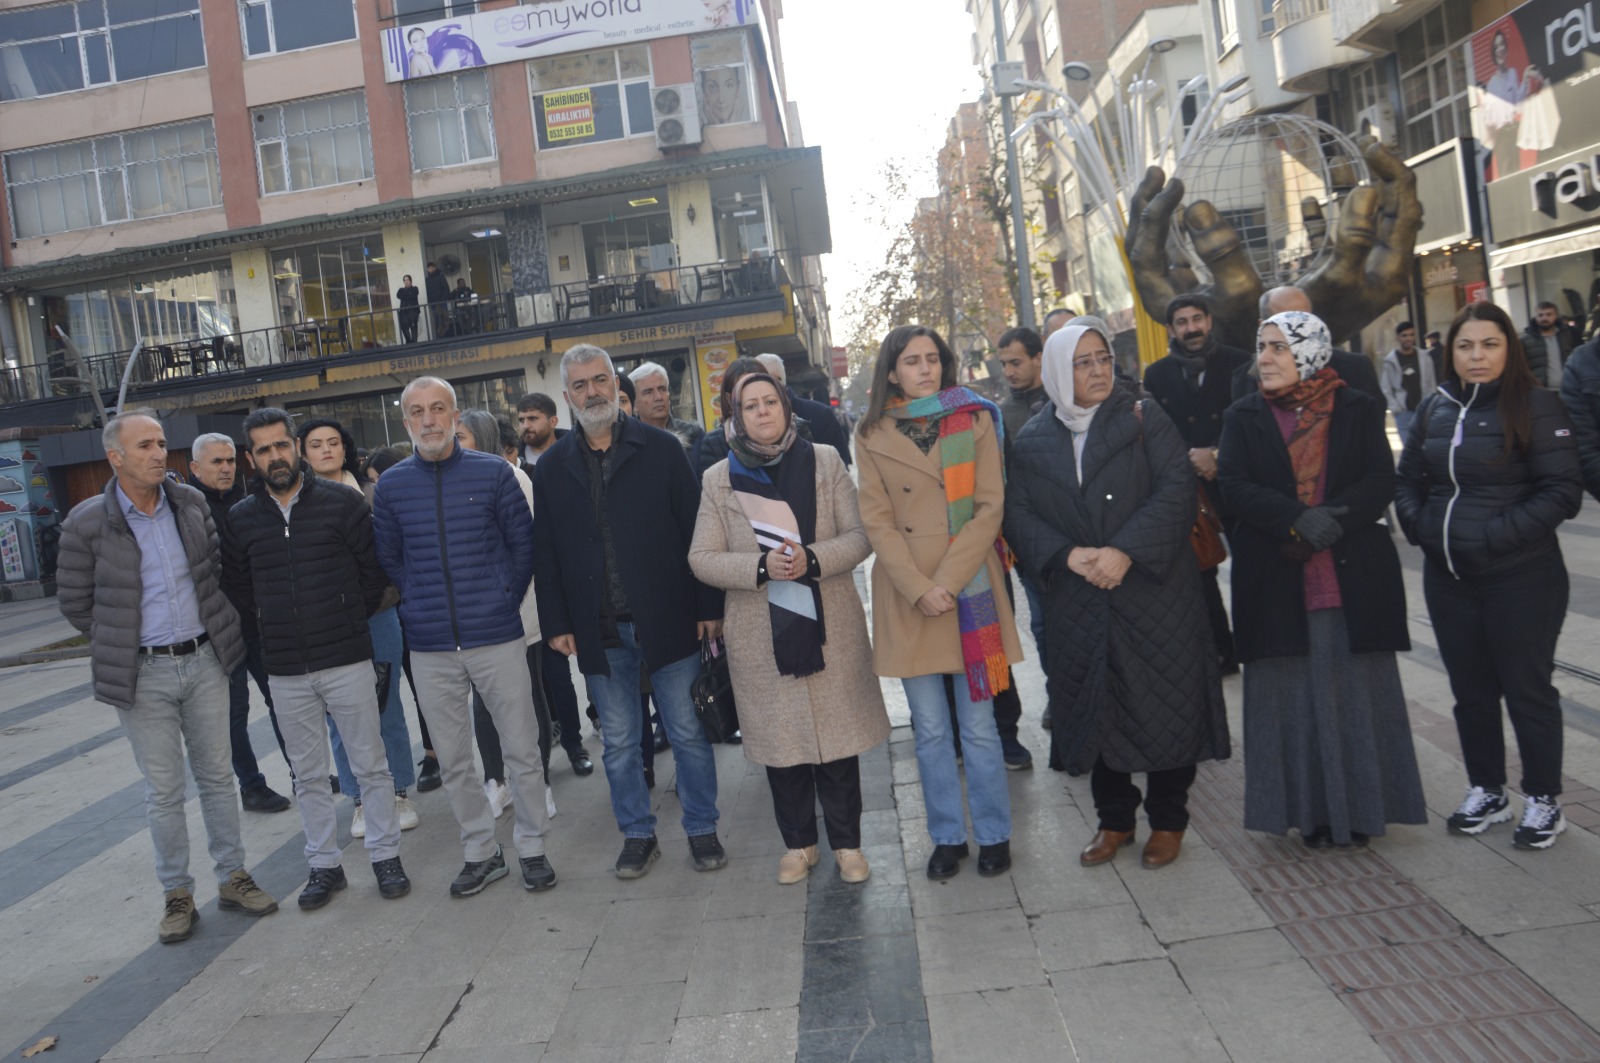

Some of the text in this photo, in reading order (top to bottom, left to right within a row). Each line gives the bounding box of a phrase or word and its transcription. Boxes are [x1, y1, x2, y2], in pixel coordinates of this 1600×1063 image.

[603, 29, 628, 39] beauty
[634, 24, 661, 35] medical
[667, 19, 695, 30] esthetic
[545, 91, 590, 108] SAHİBİNDEN
[547, 108, 590, 124] KIRALIKTIR
[549, 128, 564, 139] 0532
[564, 126, 576, 137] 553
[619, 321, 714, 343] ŞEHİR SOFRASI
[389, 348, 479, 371] ŞEHİR SOFRASI
[210, 385, 259, 400] SOFRASI
